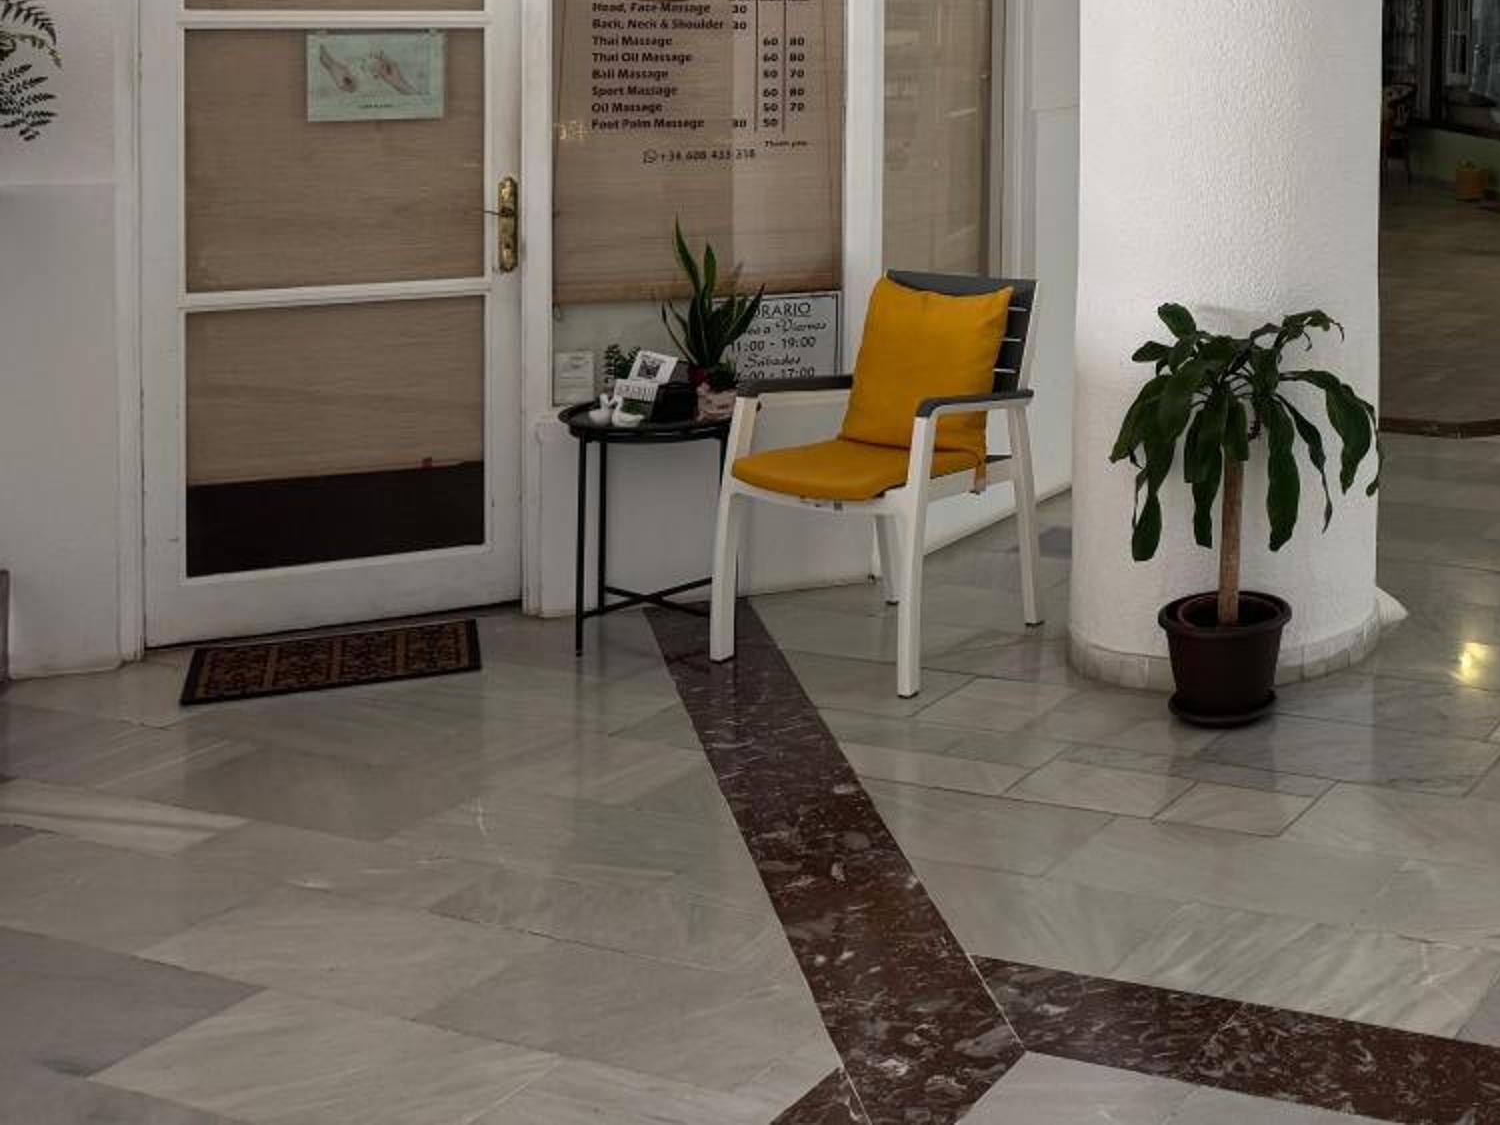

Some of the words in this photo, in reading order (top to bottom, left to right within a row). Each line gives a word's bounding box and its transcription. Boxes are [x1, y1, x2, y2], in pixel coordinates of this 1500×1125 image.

[661, 2, 711, 15] Massage
[671, 18, 724, 30] Shoulder
[592, 35, 619, 46] Thai
[621, 35, 673, 48] Massage
[592, 52, 619, 63] Thai
[621, 52, 639, 63] Oil
[641, 52, 693, 66] Massage
[618, 68, 669, 82] Massage
[592, 85, 624, 98] Sport
[627, 85, 679, 98] Massage
[592, 103, 609, 113] Oil
[611, 103, 663, 115] Massage
[653, 118, 705, 131] Massage
[781, 335, 817, 350] 19:00
